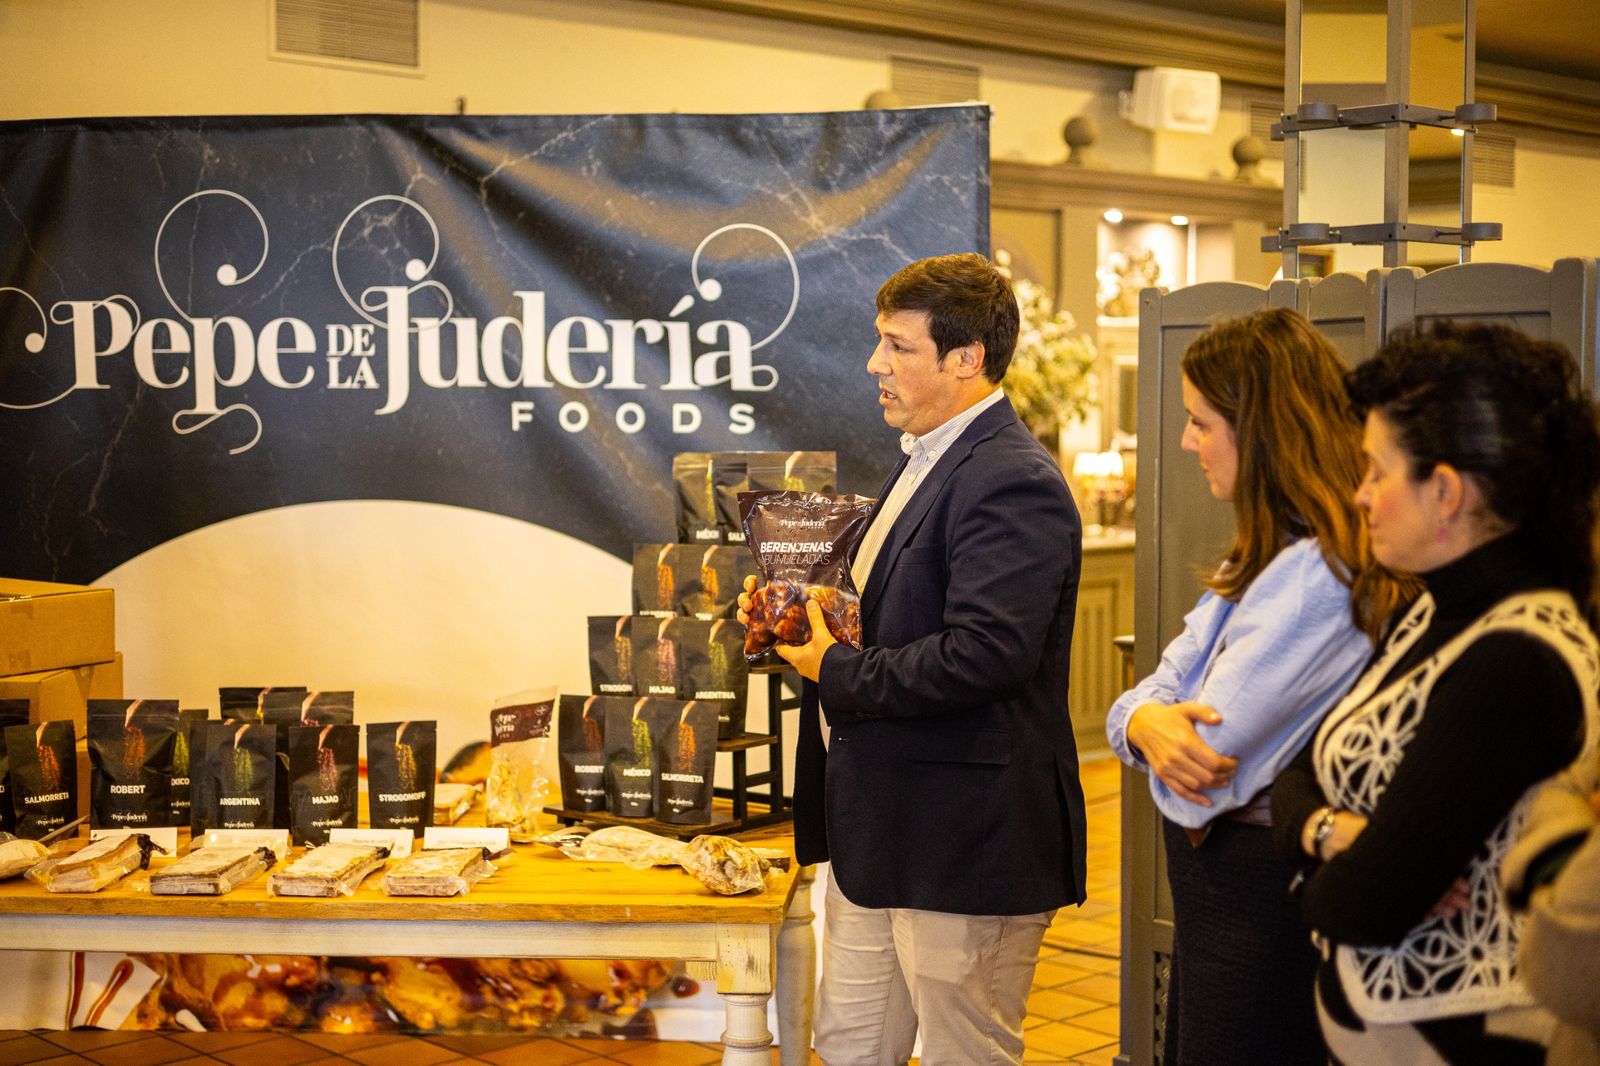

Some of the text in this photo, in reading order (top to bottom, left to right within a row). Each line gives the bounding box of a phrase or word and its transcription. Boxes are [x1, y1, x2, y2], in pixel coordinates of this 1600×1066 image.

[326, 323, 375, 356] DE
[0, 285, 317, 454] Pepe
[326, 357, 380, 390] LA
[510, 401, 756, 434] FOODS
[760, 541, 833, 554] BERENJENAS
[695, 691, 736, 700] ARGENTINA
[110, 784, 146, 794] ROBERT
[24, 791, 70, 805] SALMORRETA
[219, 797, 261, 806] ARGENTINA
[311, 795, 339, 805] MAJAO
[378, 791, 426, 803] STROGONOFF
